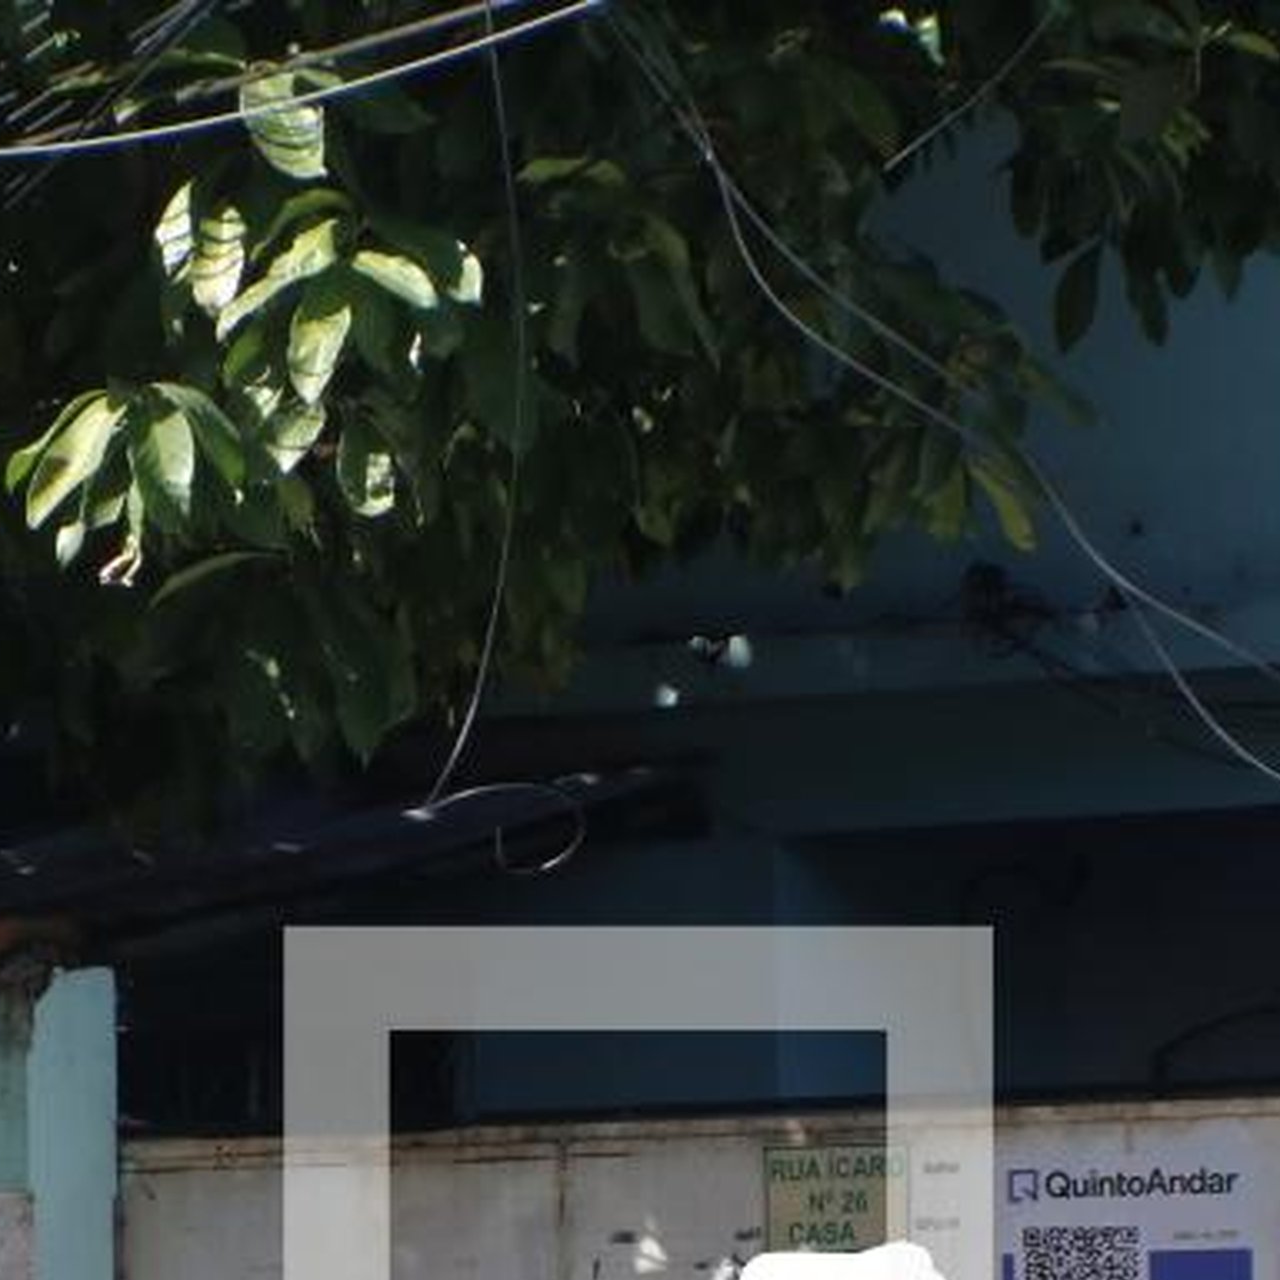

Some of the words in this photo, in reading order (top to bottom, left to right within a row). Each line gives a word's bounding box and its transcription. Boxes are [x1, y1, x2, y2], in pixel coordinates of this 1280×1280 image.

[770, 1156, 822, 1181] RUA
[1045, 1167, 1239, 1199] QuintoAndar
[788, 1220, 856, 1244] CASA
